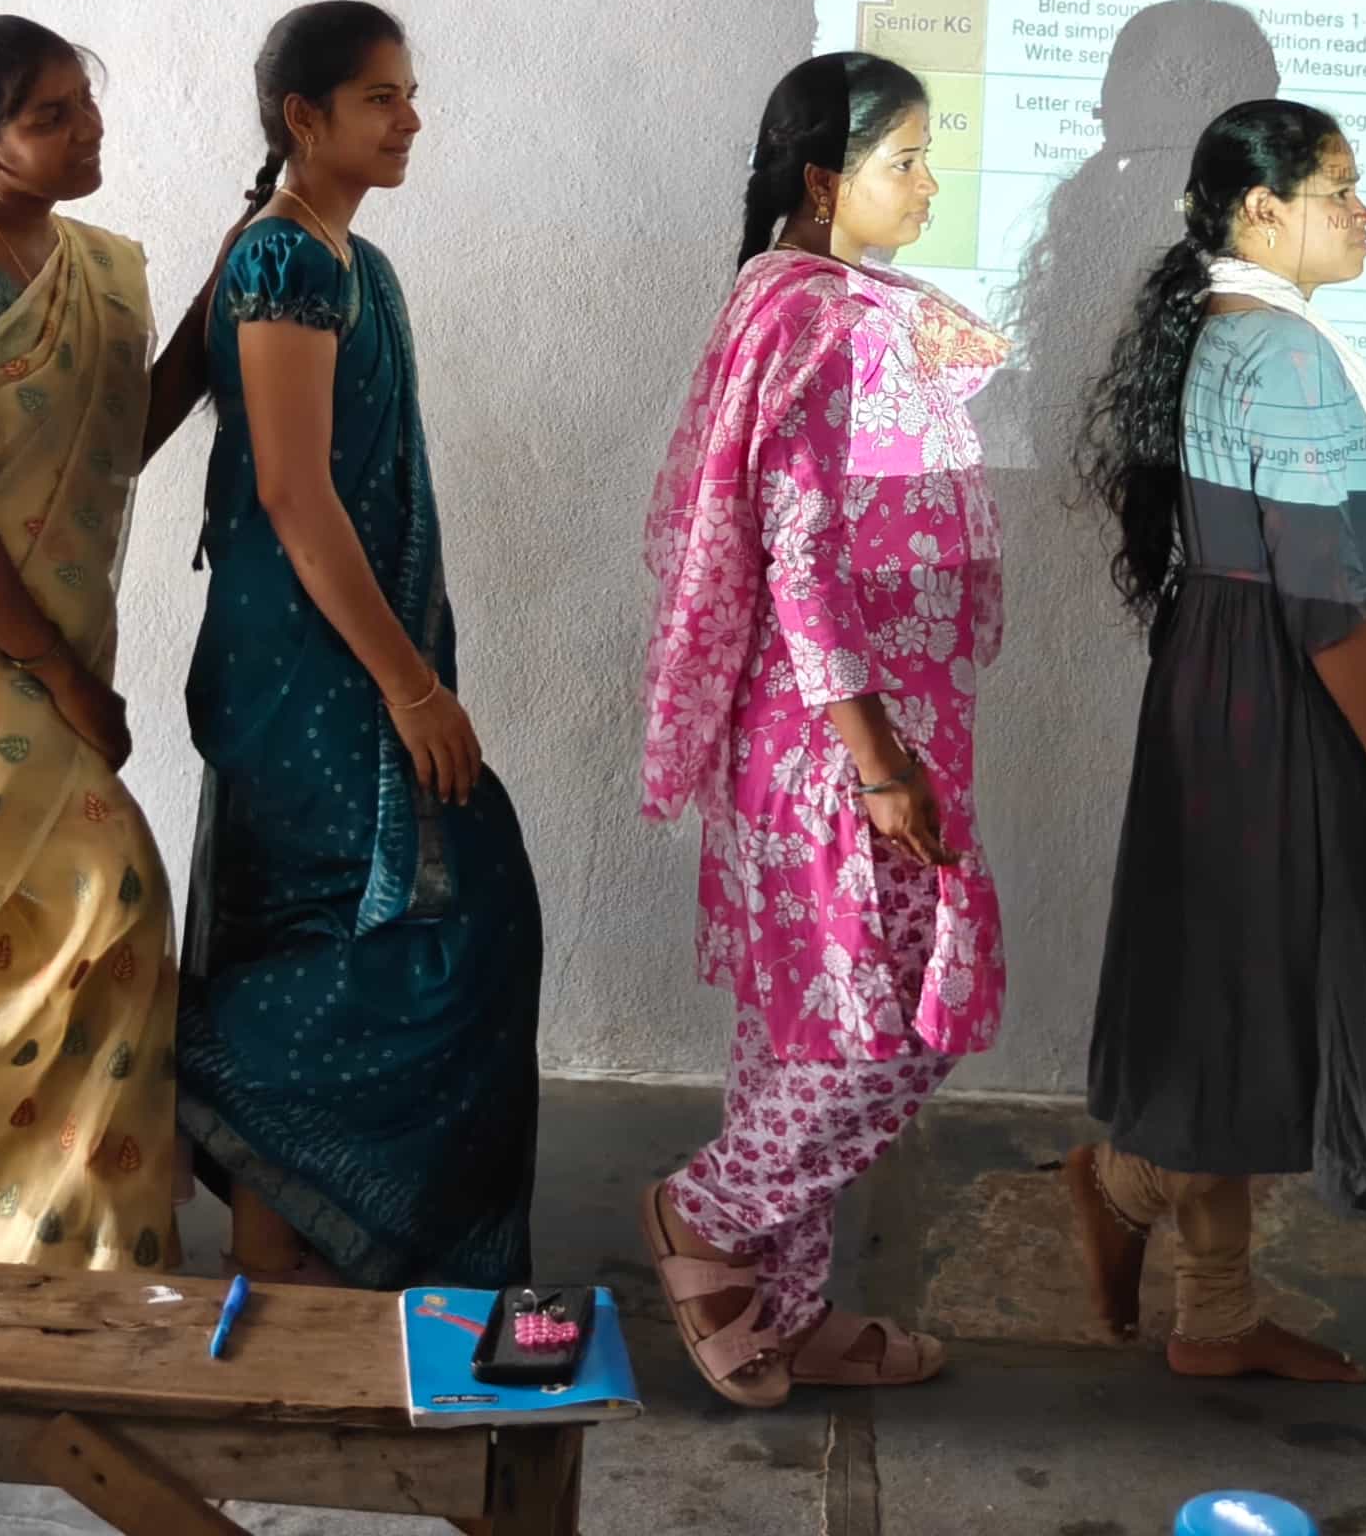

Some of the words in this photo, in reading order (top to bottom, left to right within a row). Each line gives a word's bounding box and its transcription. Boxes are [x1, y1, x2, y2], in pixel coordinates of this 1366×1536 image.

[1096, 2, 1145, 18] soun
[1258, 7, 1344, 29] Numbers
[873, 12, 938, 33] Senior
[943, 16, 972, 33] KG
[1012, 19, 1059, 38] Read
[1064, 22, 1119, 43] simpl
[1267, 32, 1321, 52] dition
[1025, 44, 1073, 63] Write
[1078, 49, 1112, 64] sen
[1015, 94, 1069, 112] Letter
[939, 113, 967, 131] KG
[1034, 142, 1088, 161] Name
